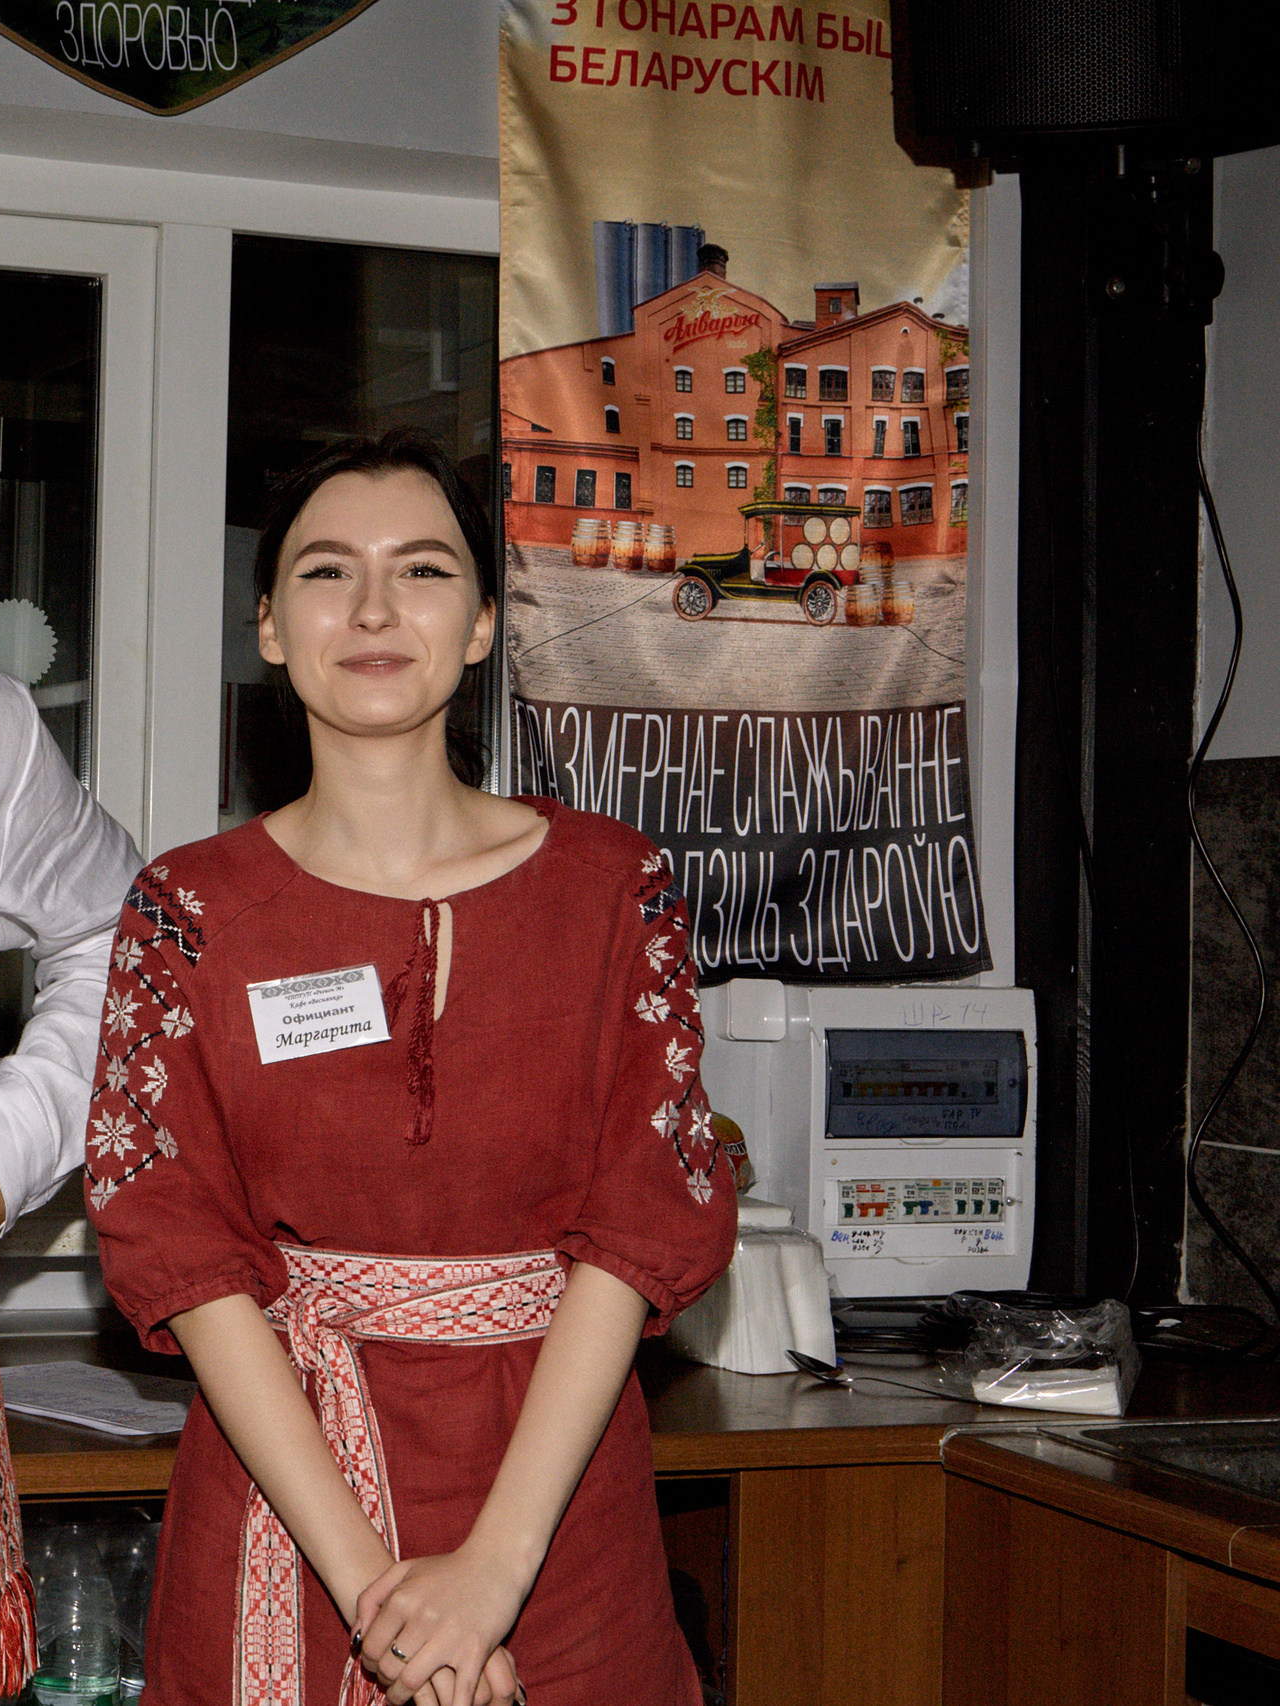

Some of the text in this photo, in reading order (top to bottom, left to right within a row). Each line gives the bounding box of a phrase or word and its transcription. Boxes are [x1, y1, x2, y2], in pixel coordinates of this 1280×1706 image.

[56, 0, 237, 72] ЗДОРОВЬЮ
[549, 44, 826, 104] БЕЛАРУСКІМ
[732, 706, 966, 837] СПАЖЫВАННЕ
[789, 832, 981, 973] ЗДАРОЎЮ
[275, 1019, 373, 1049] Маргарита
[282, 1004, 356, 1025] Официант
